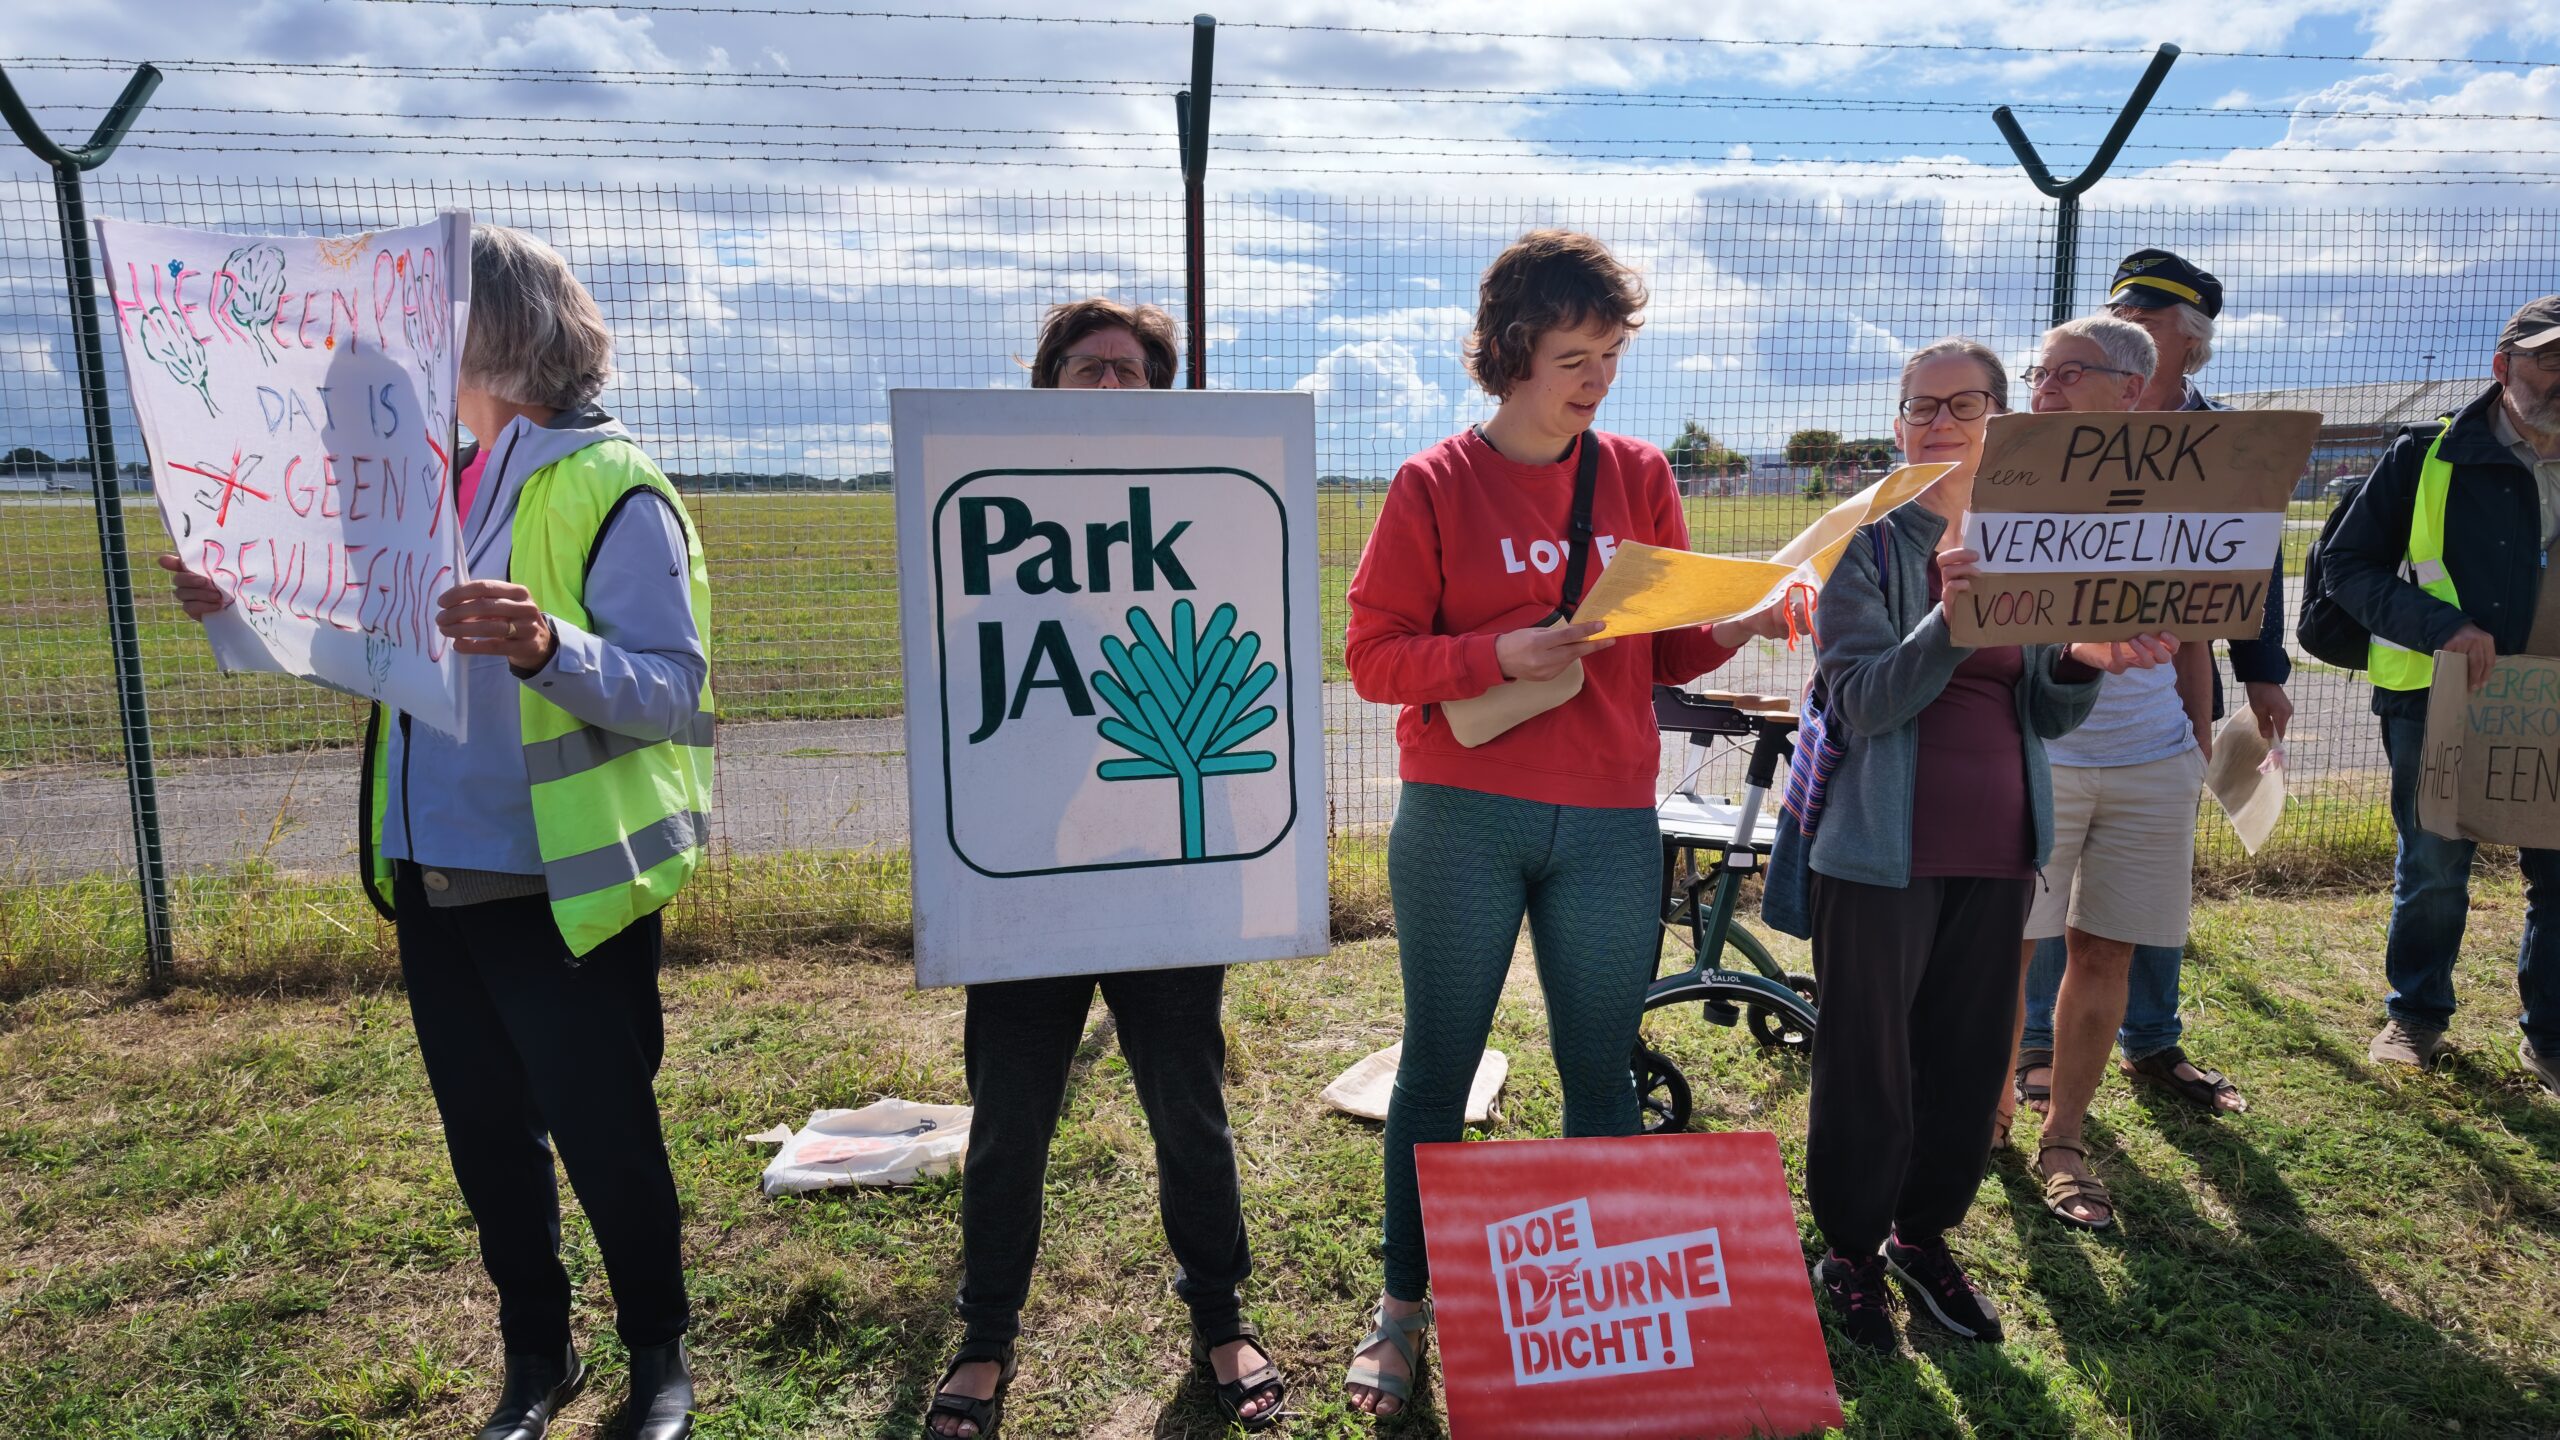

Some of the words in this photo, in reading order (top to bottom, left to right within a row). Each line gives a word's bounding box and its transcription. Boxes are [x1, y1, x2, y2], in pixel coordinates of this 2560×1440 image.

[114, 262, 250, 346] HIER
[272, 287, 359, 354] EEN
[257, 385, 336, 438] DAT
[370, 383, 398, 439] IS
[1987, 467, 2041, 486] een
[2059, 423, 2221, 482] PARK
[285, 455, 407, 521] GEEN
[959, 486, 1197, 596] Park
[1974, 589, 2056, 629] VOOR
[2067, 578, 2263, 627] IEDEREEN
[968, 620, 1096, 744] JA
[2422, 741, 2463, 800] HIER
[1712, 975, 1741, 983] SALJOL
[1499, 1207, 1579, 1265] DOE
[1505, 1243, 1720, 1328] DEURNE
[1519, 1312, 1676, 1377] DICHT!
